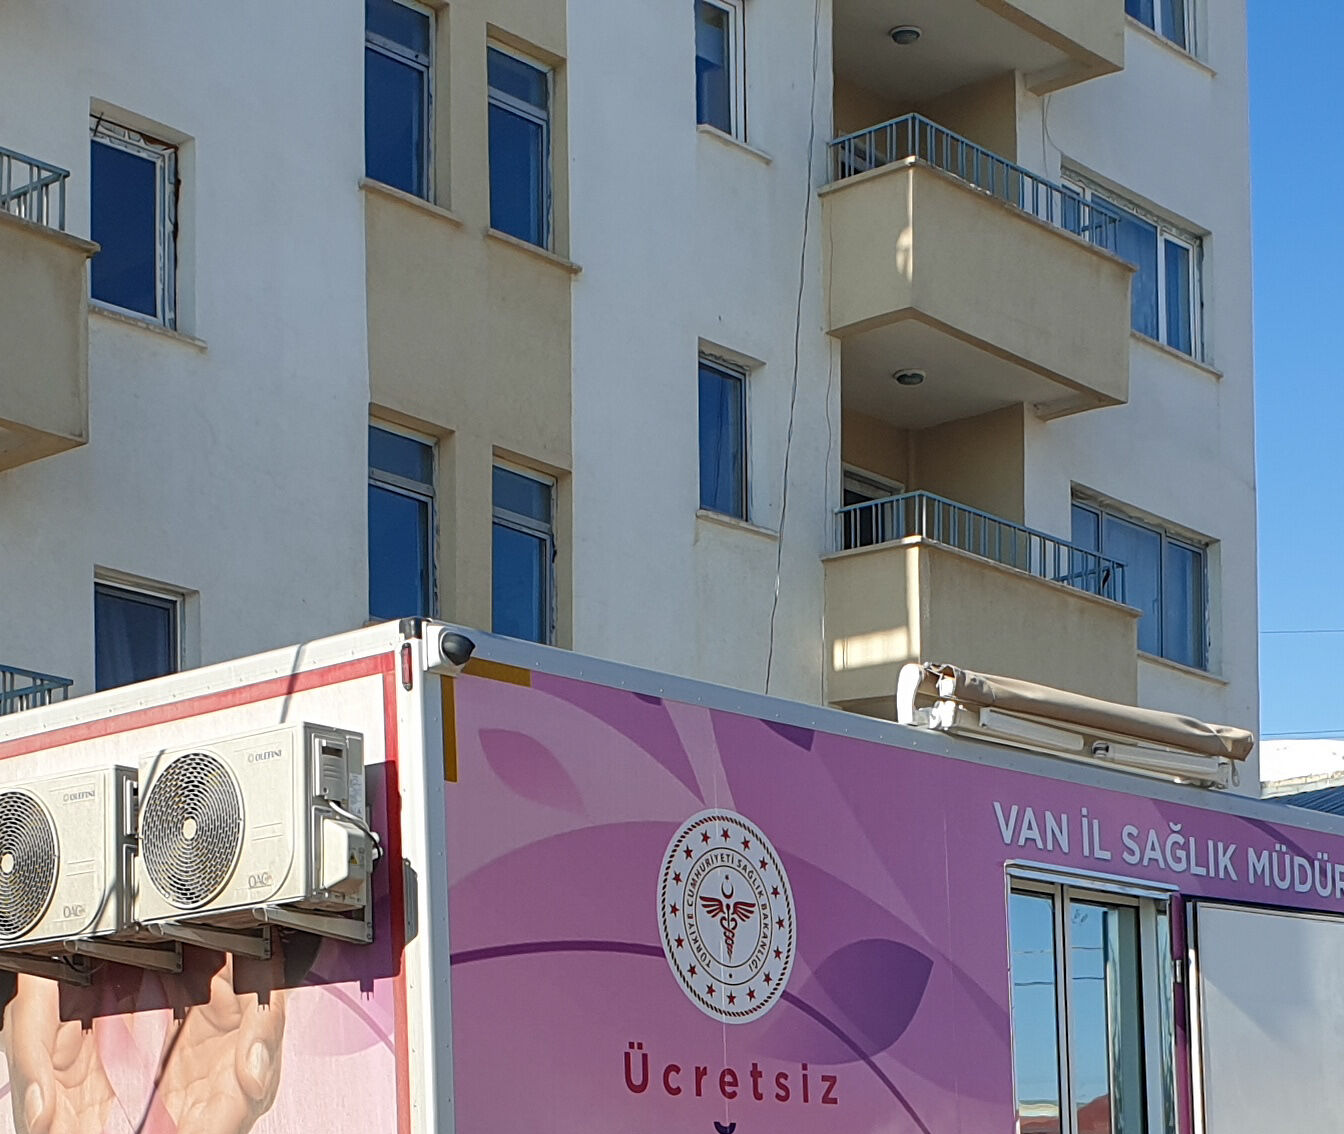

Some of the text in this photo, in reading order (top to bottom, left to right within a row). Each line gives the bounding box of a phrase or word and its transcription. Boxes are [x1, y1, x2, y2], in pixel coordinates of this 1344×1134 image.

[993, 801, 1068, 854] VAN
[1081, 807, 1111, 861] İL
[1121, 822, 1238, 881] SAĞLIK
[686, 852, 736, 908] CUMHURİYETİ
[736, 858, 765, 899] SAĞLIK
[748, 903, 771, 974] BAKANLIĞI
[623, 1041, 839, 1105] Ücretsiz
